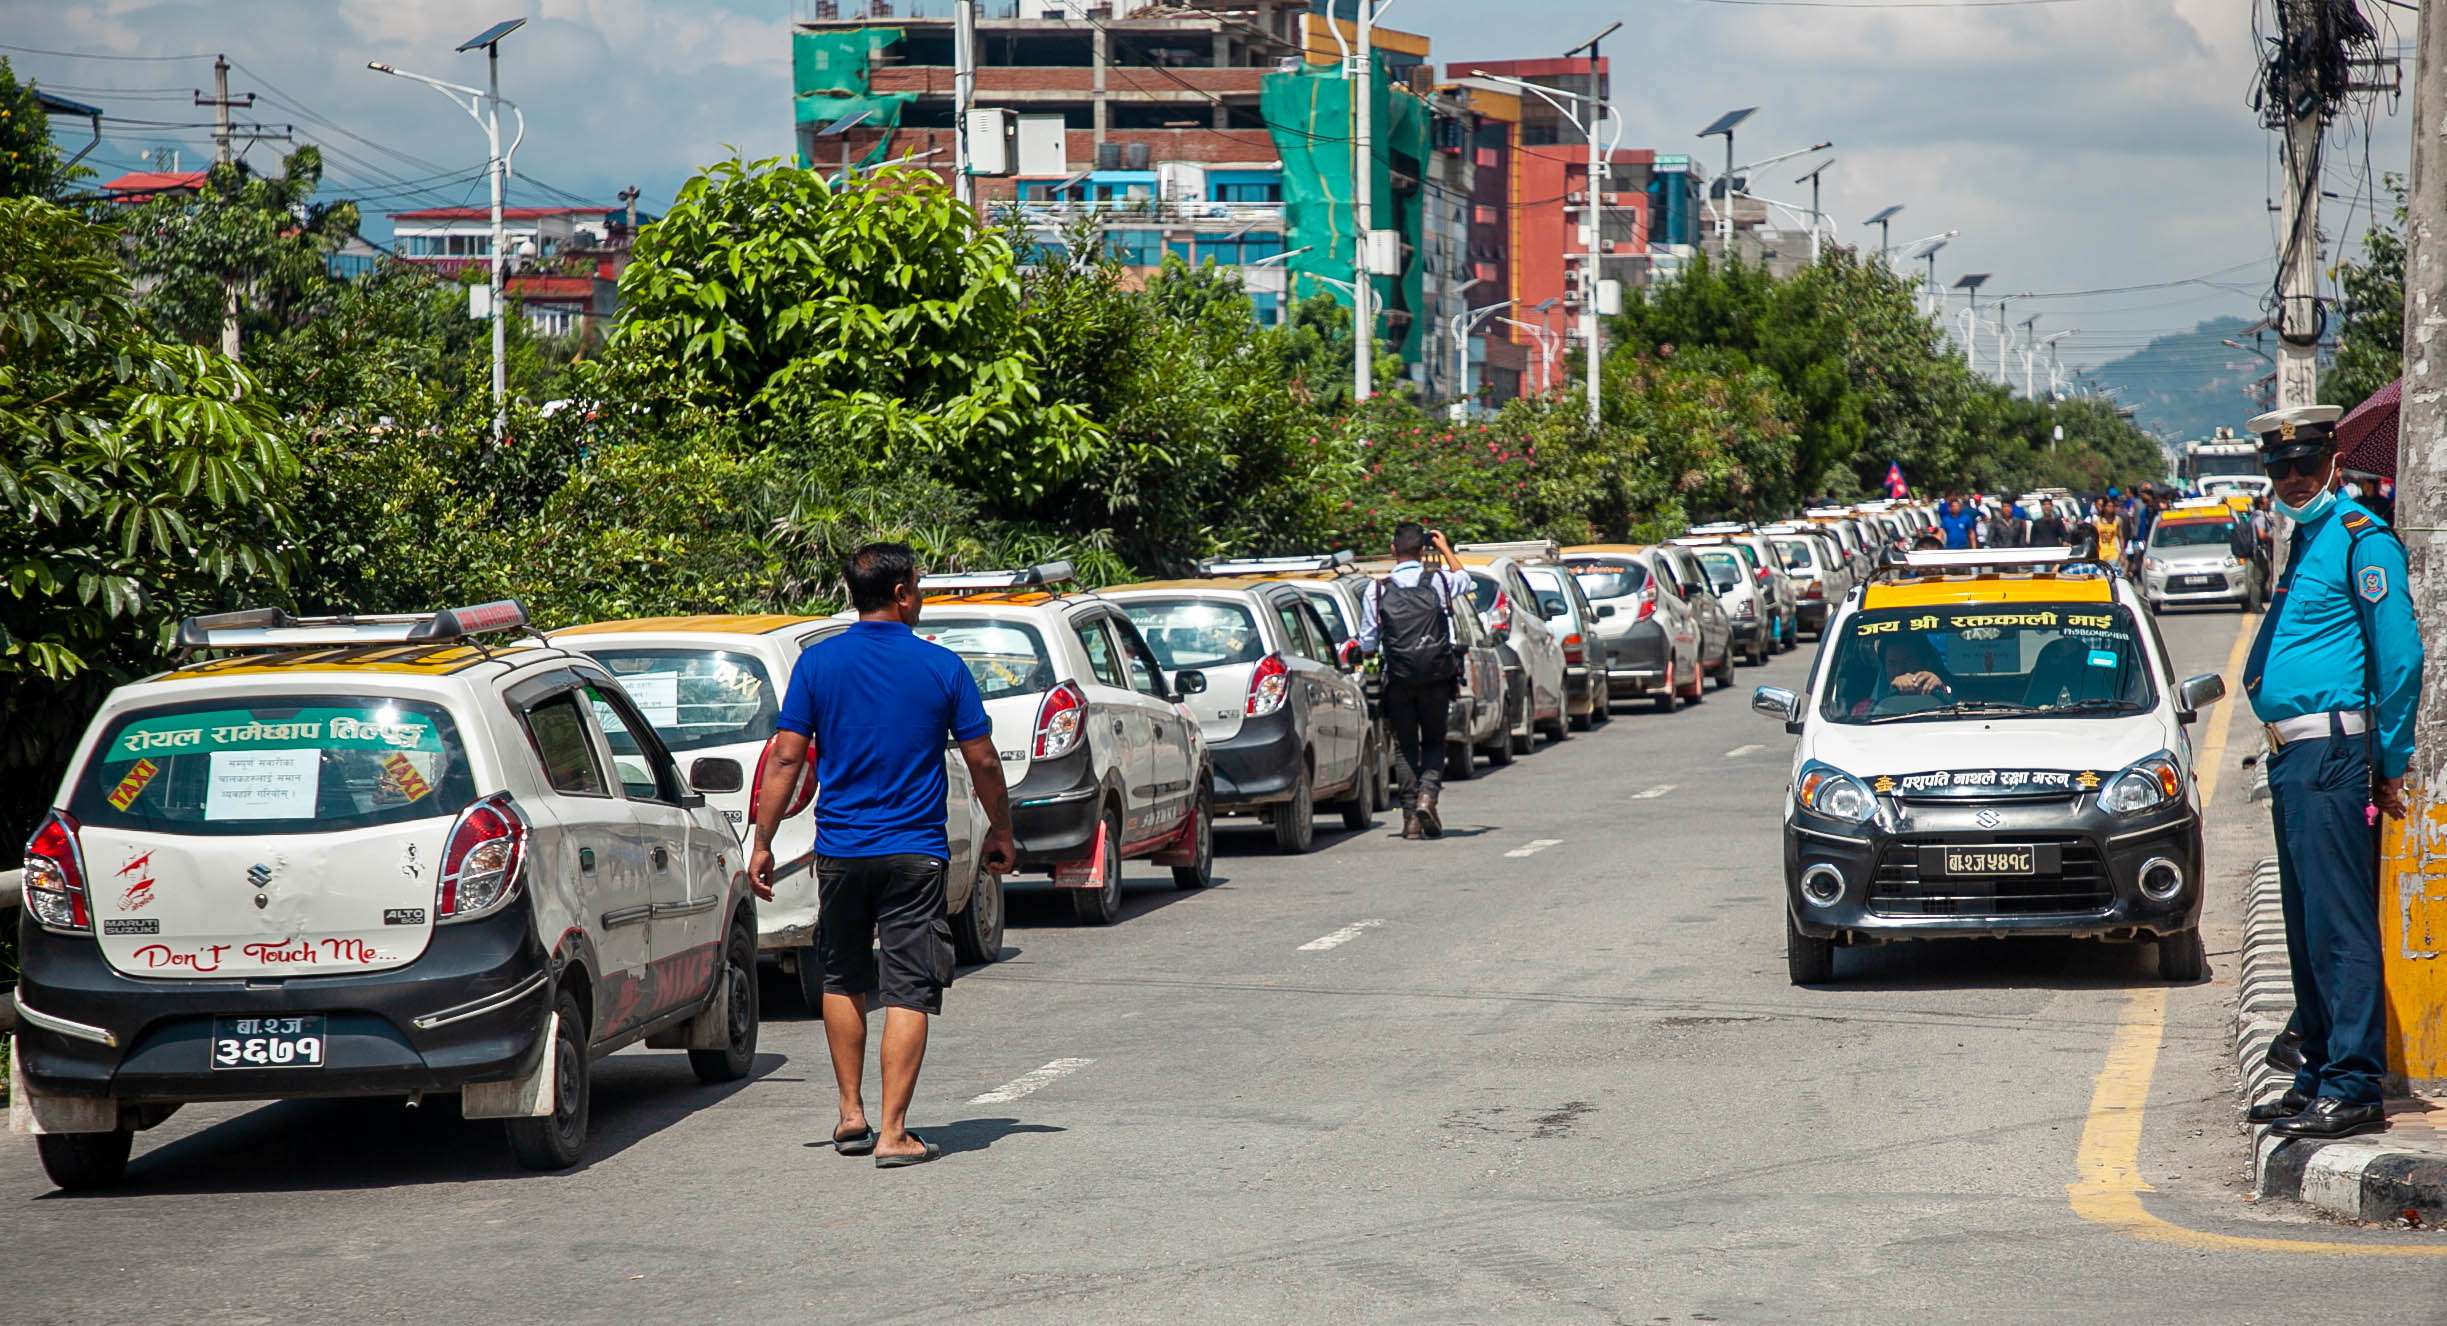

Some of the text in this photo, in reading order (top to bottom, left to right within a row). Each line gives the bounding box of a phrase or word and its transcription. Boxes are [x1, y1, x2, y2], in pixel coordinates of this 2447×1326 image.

[1857, 620, 1901, 636] जय
[1910, 615, 1940, 631] श्री
[124, 728, 203, 751] रोयल
[211, 721, 322, 743] रामेछाप
[110, 760, 158, 806] TAXI
[384, 751, 432, 801] TAXI
[1902, 770, 1951, 790] पशुपति
[1953, 769, 1997, 785] नाथले
[106, 920, 159, 928] MARUTI
[386, 909, 424, 919] ALTO
[400, 916, 424, 924] 800
[133, 944, 232, 972] Don't
[243, 937, 317, 965] Touch
[216, 1037, 321, 1065] ३६७१
